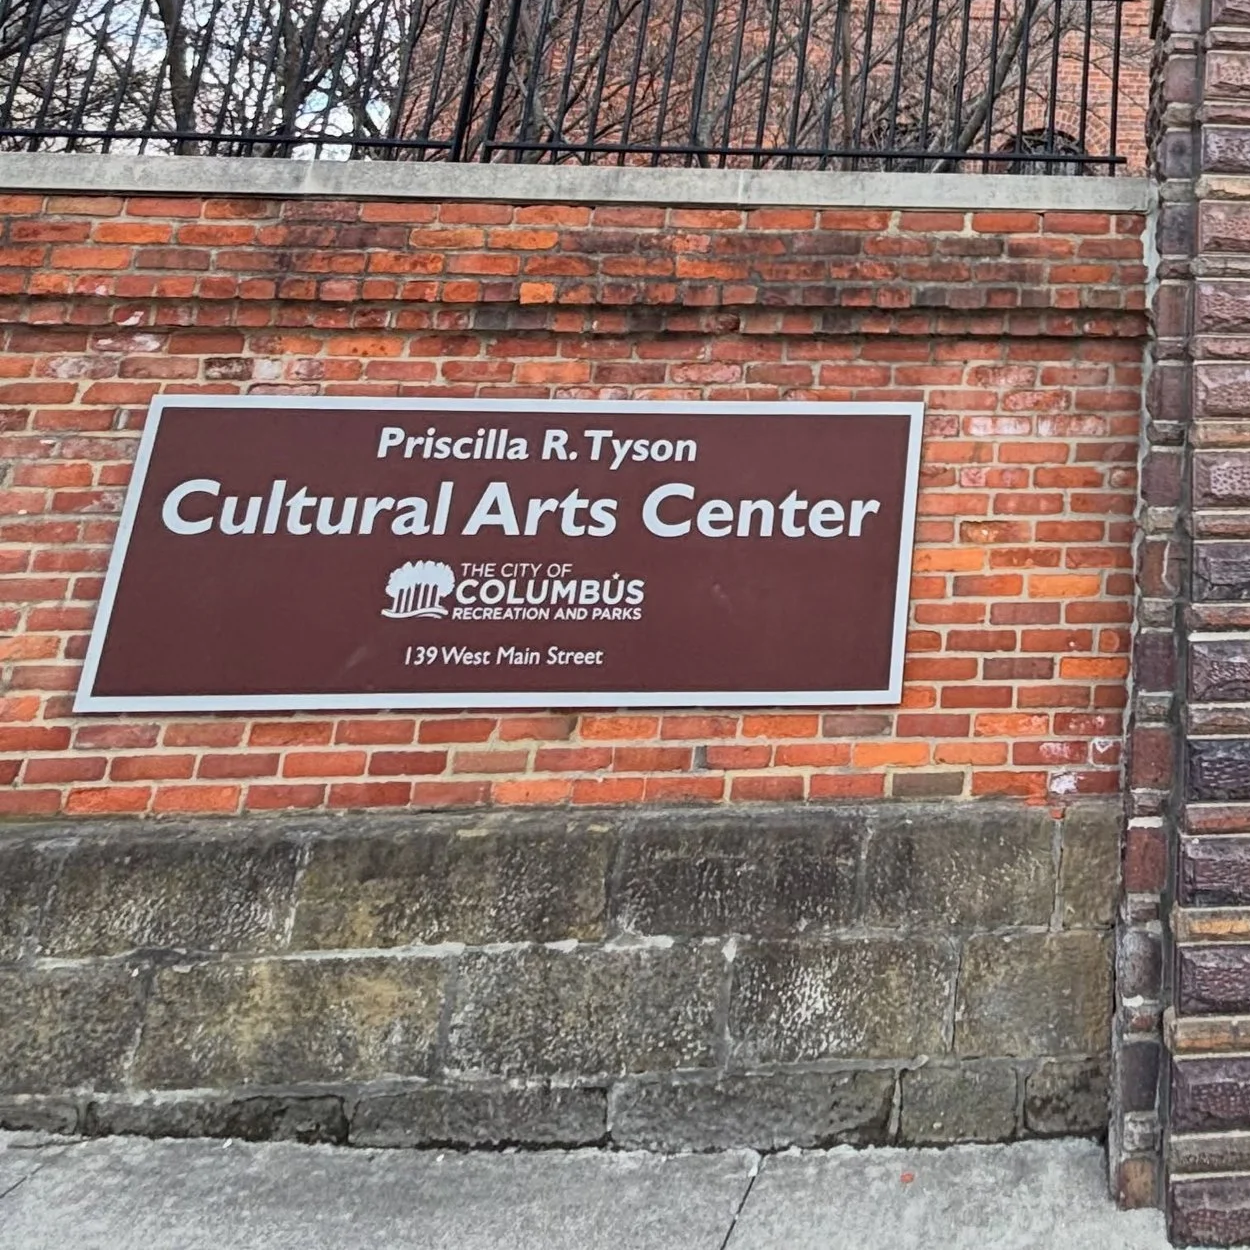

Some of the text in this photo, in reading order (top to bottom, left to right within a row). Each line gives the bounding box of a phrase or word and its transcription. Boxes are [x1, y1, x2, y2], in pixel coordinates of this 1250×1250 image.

[376, 426, 698, 471] Priscilla R. Tyson
[161, 478, 881, 538] Cultural Arts Center
[460, 562, 573, 578] THE CITY OF
[455, 578, 645, 605] COLUMBUS
[451, 606, 642, 621] RECREATION AND PARKS
[404, 645, 604, 666] 139 West Main Street
